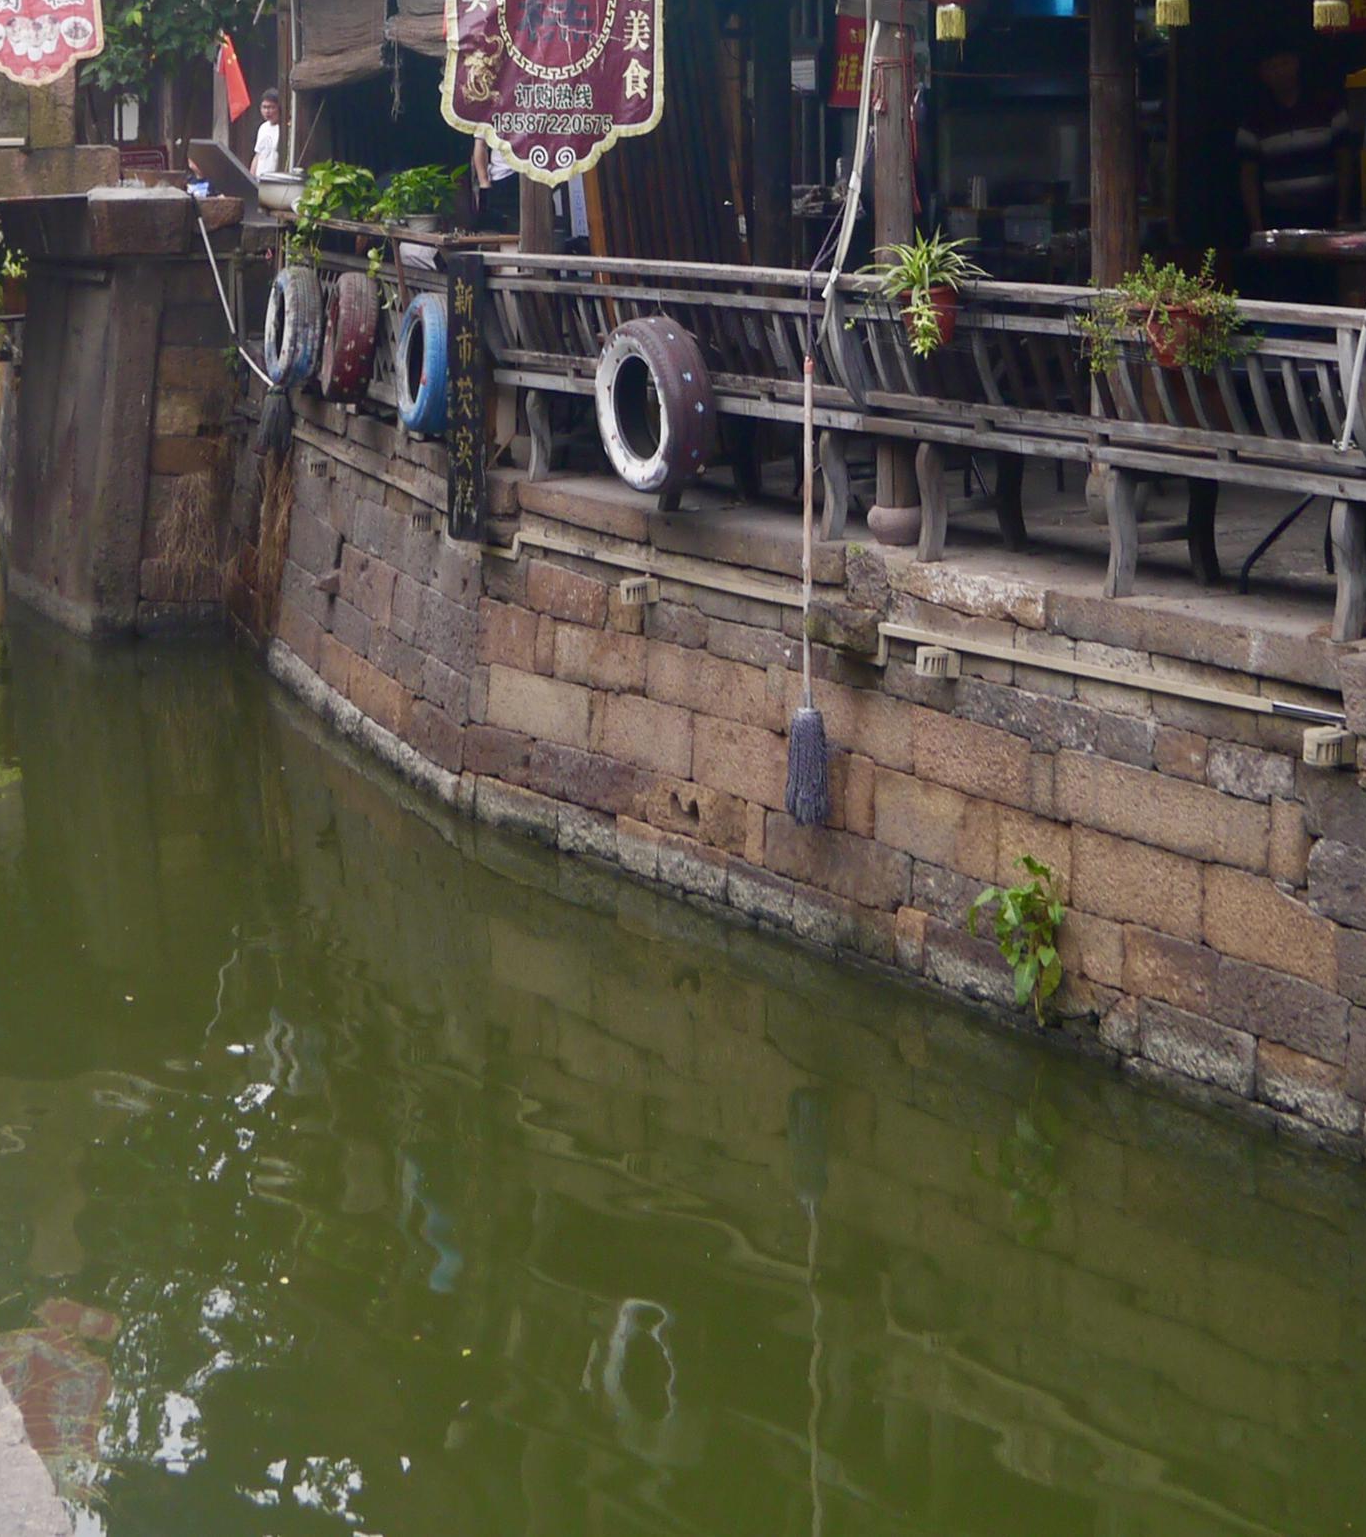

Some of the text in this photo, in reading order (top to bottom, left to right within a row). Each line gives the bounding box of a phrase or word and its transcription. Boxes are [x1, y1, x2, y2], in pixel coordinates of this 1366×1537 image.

[515, 83, 593, 111] 订购热线
[492, 114, 613, 134] 13587220575
